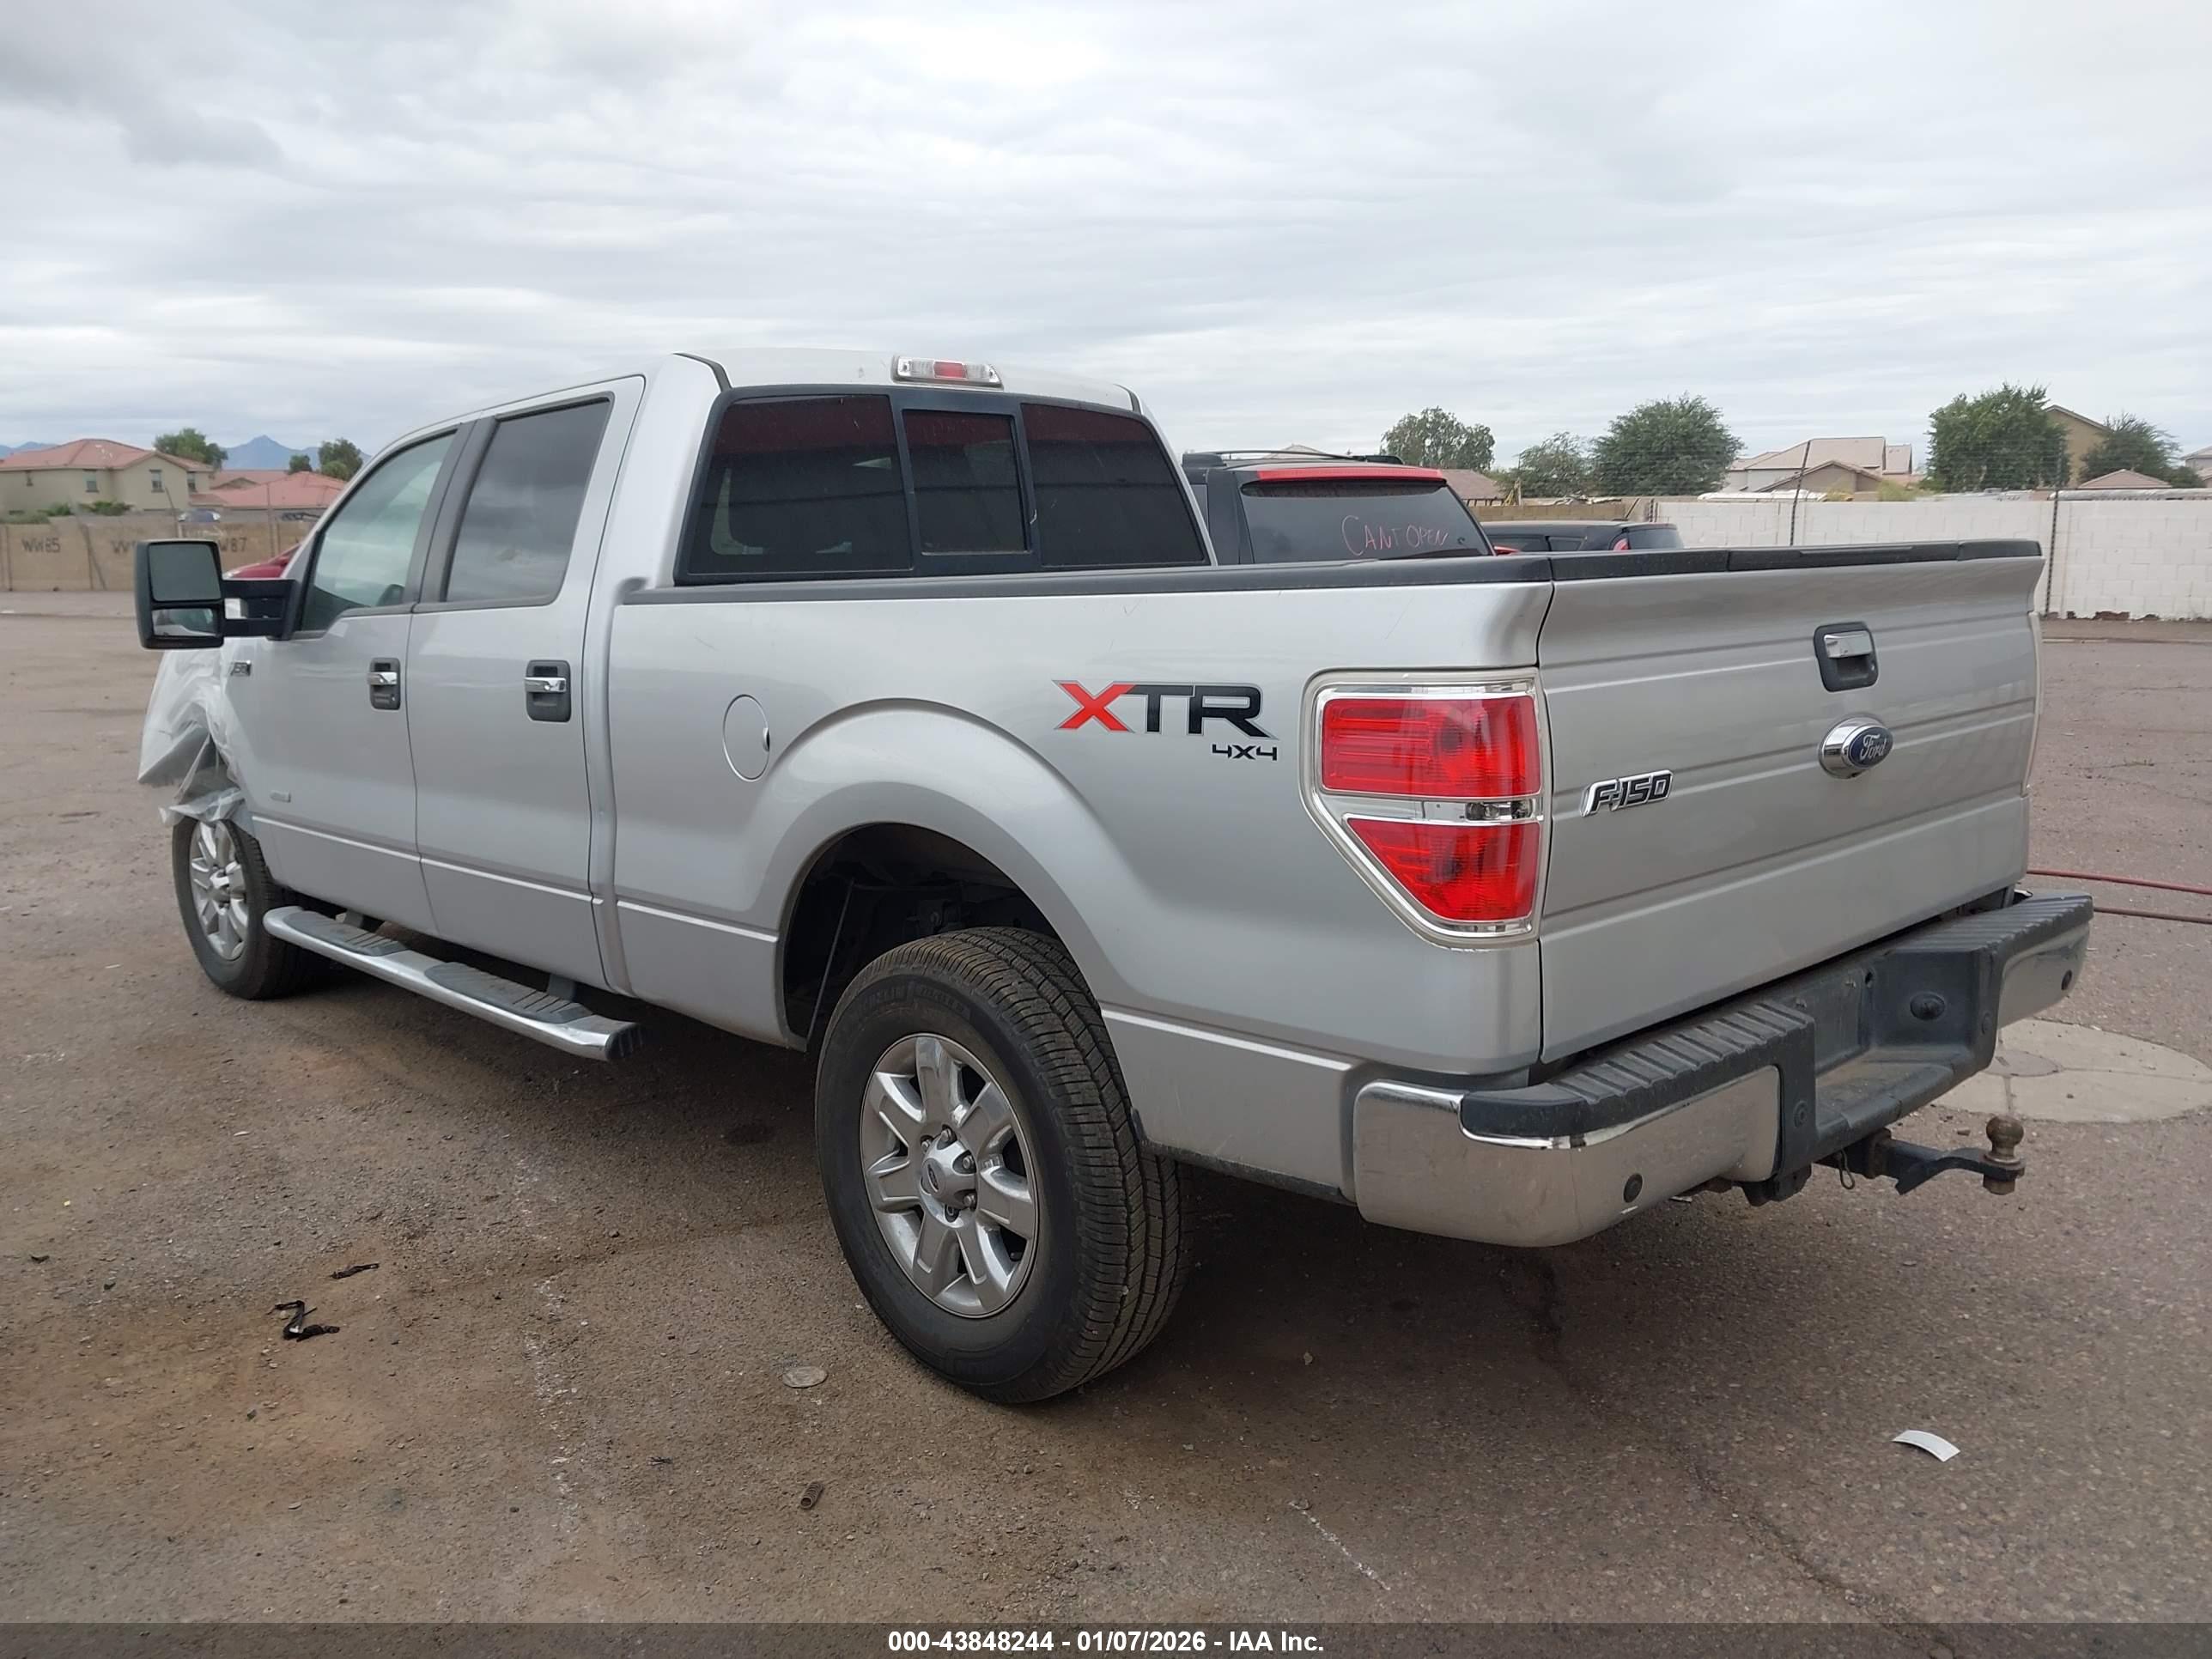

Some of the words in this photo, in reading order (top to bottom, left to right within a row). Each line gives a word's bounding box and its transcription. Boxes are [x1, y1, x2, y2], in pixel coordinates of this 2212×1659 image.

[1406, 524, 1449, 548] OPEN
[1053, 680, 1278, 740] XTR
[1859, 733, 1887, 761] Ford
[1580, 770, 1673, 817] F-150
